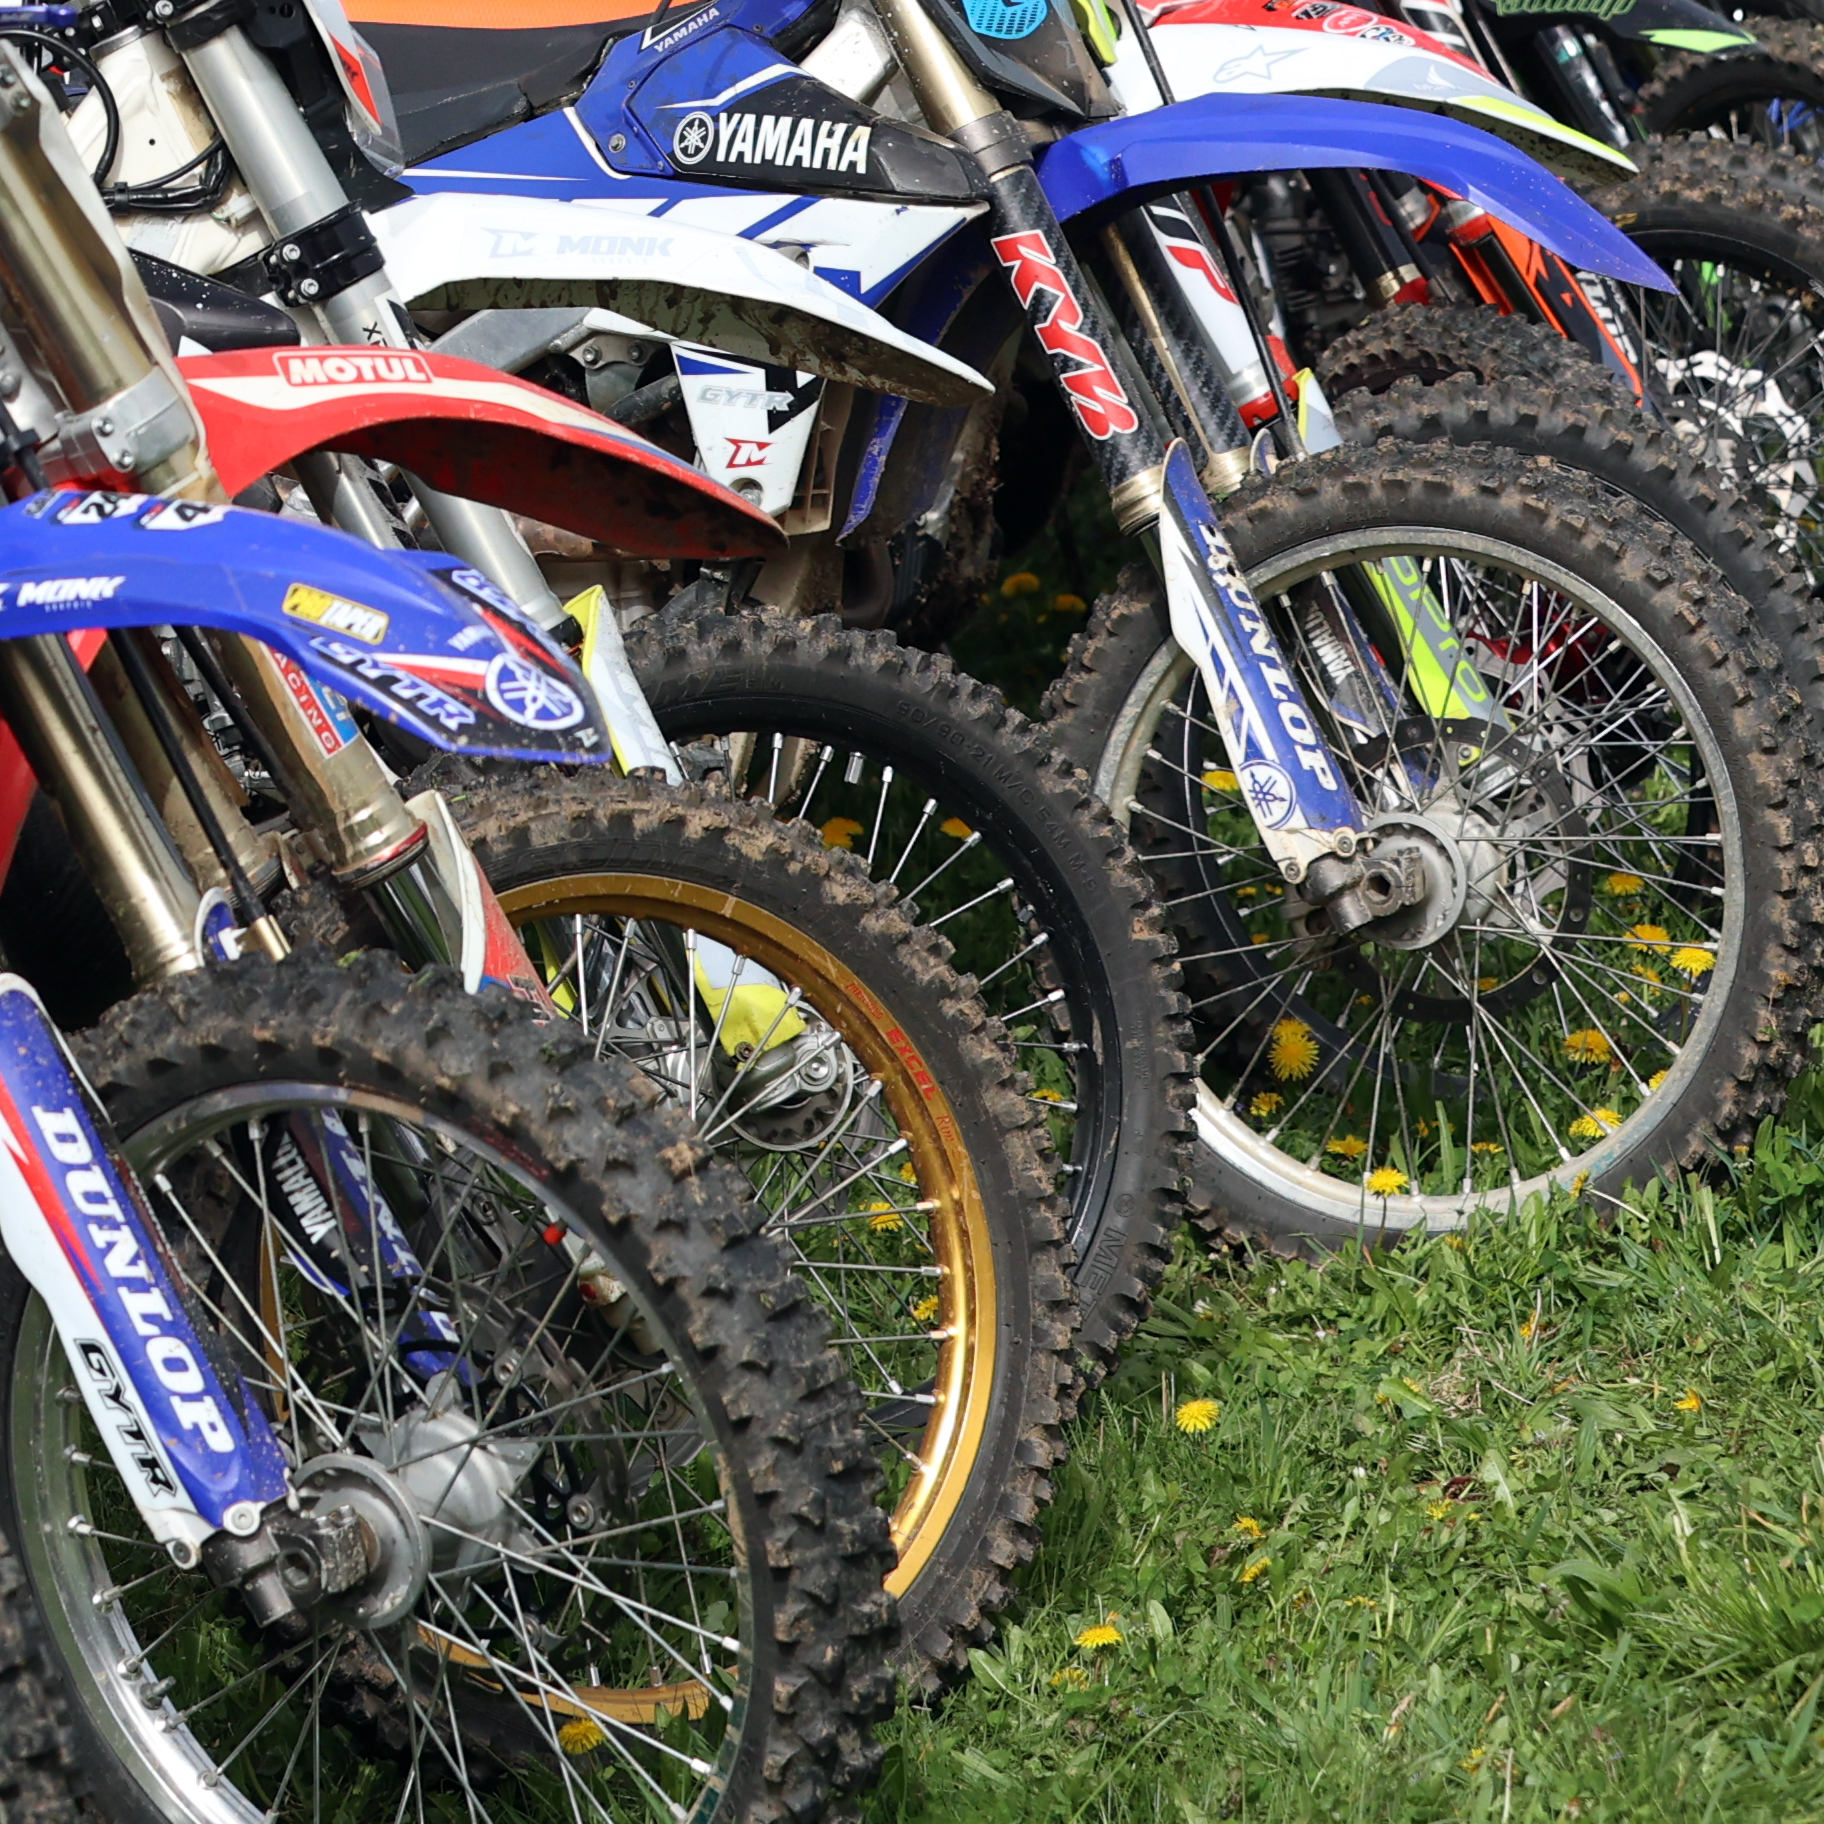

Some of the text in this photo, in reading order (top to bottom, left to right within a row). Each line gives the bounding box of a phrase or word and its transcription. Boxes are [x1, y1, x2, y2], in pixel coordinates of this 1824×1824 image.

[654, 7, 720, 54] YAMAHA
[715, 111, 873, 175] YAMAHA
[287, 355, 429, 385] MOTUL
[697, 385, 795, 412] GYTR
[16, 576, 126, 608] MONK
[272, 649, 339, 750] ACING
[885, 1026, 939, 1102] EXCEL
[31, 1104, 236, 1454] DUNLOP
[73, 1338, 178, 1498] GYTR
